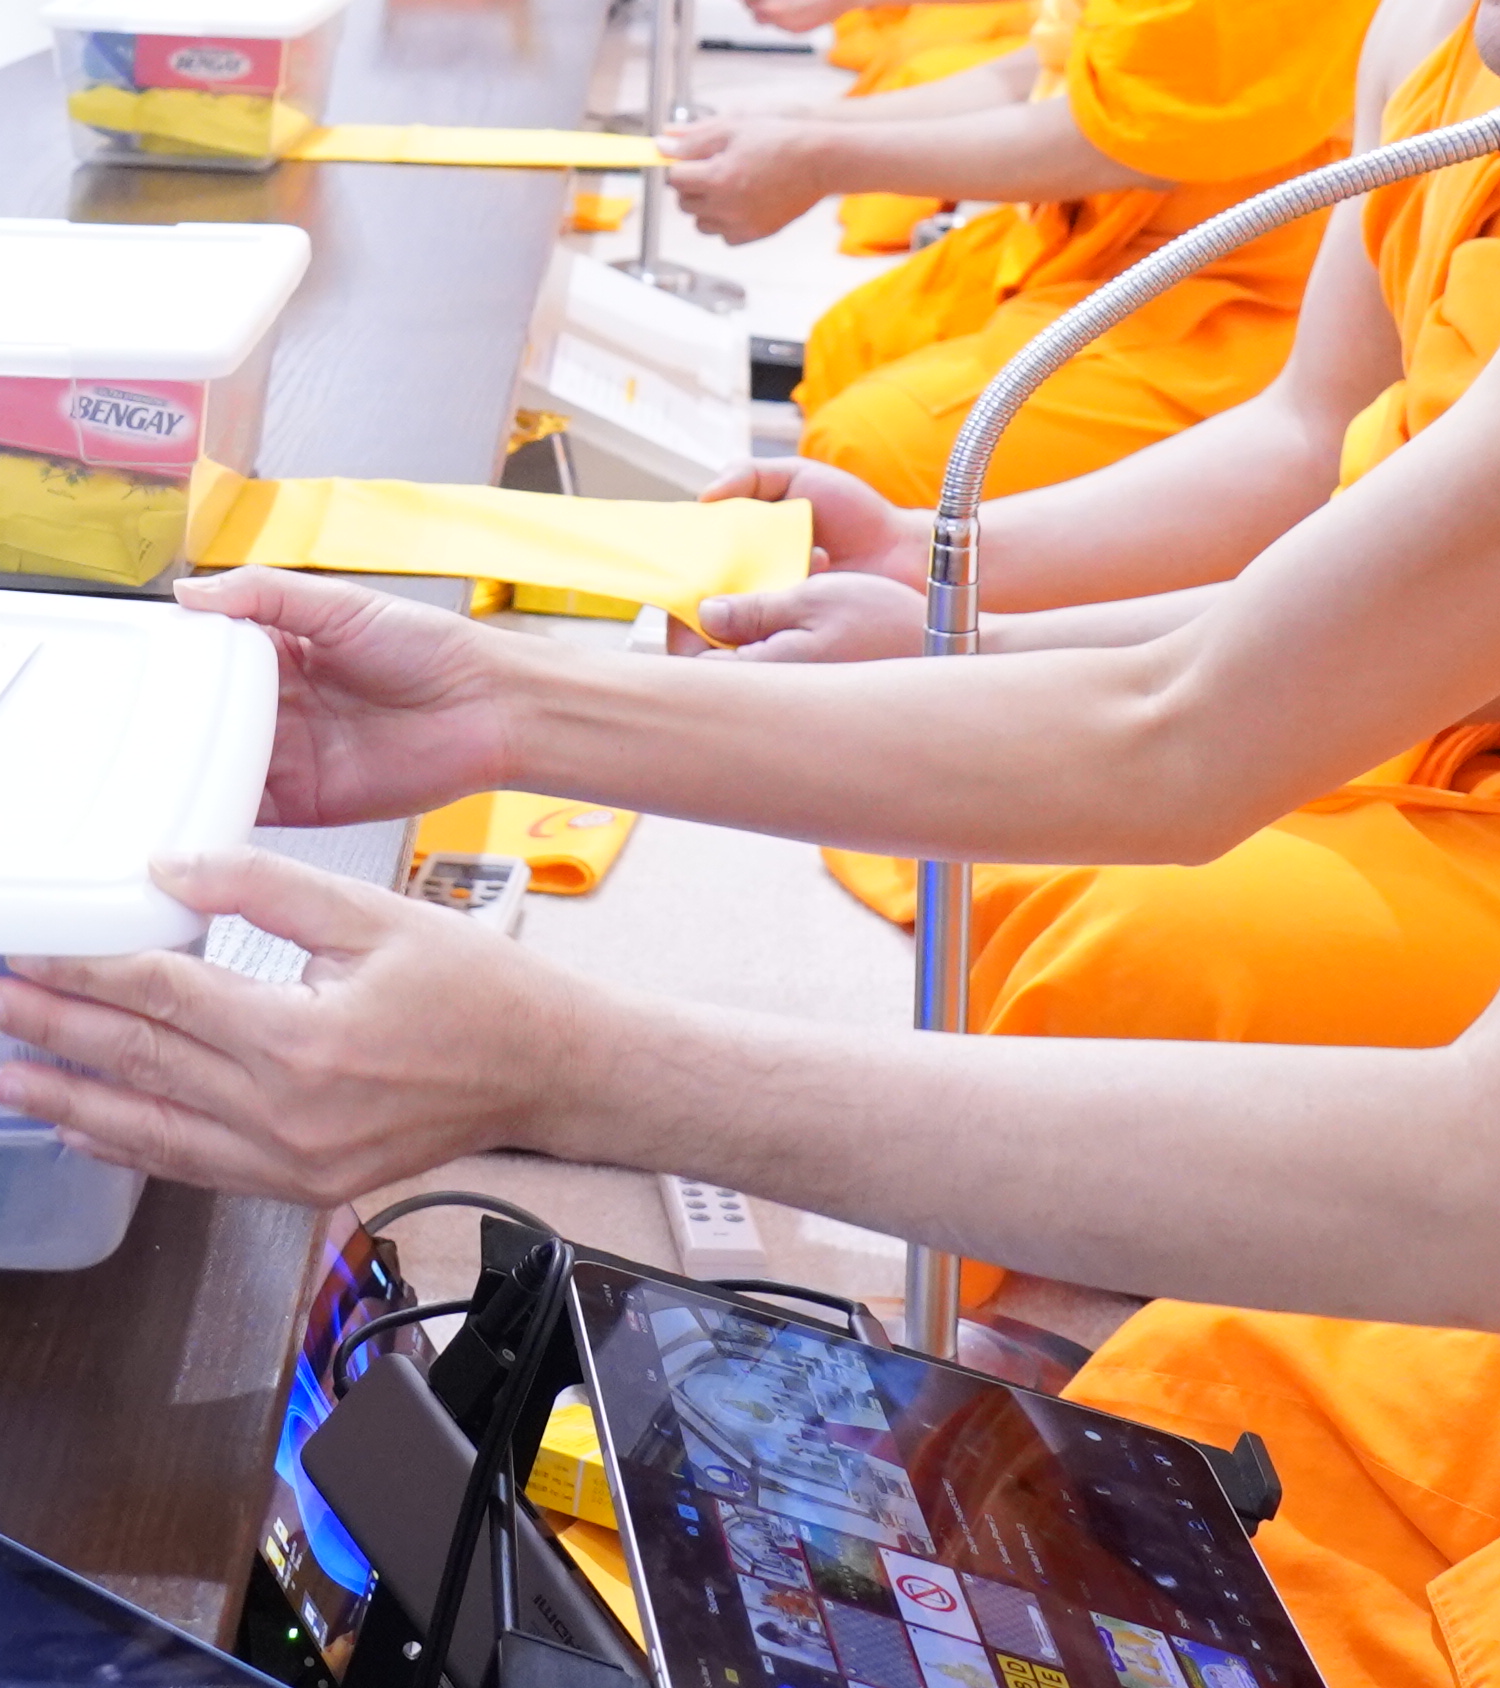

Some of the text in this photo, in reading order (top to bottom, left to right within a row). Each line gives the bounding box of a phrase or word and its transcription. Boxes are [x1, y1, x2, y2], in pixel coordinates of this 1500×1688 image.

[70, 396, 184, 436] BENGAY
[1007, 1661, 1027, 1673] D
[1042, 1672, 1062, 1683] E
